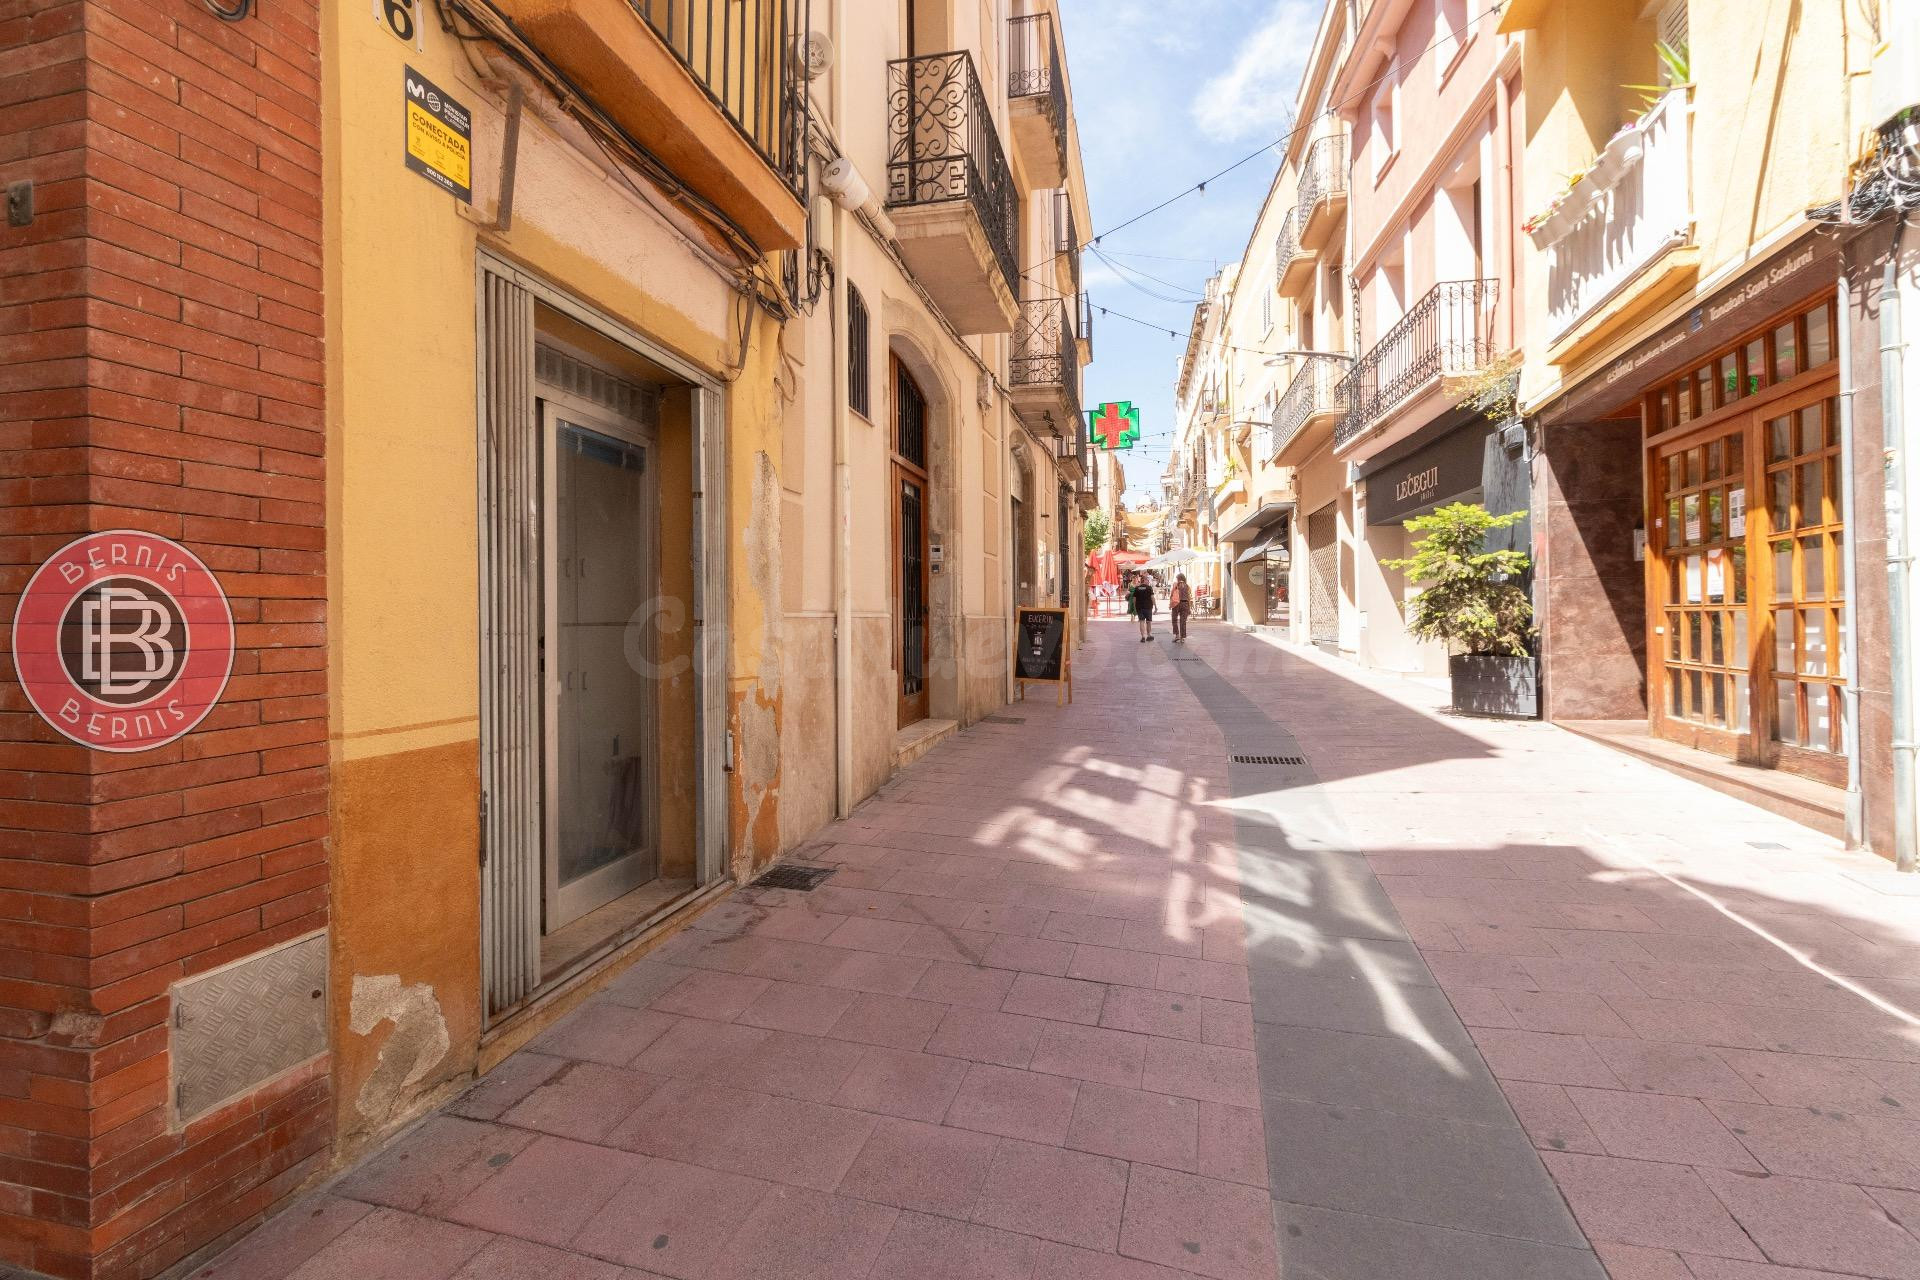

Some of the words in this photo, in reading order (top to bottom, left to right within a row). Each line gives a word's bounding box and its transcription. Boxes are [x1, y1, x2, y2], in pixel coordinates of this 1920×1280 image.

[383, 0, 414, 41] 6
[412, 111, 466, 154] CONECTADA
[1745, 276, 1769, 299] Sant
